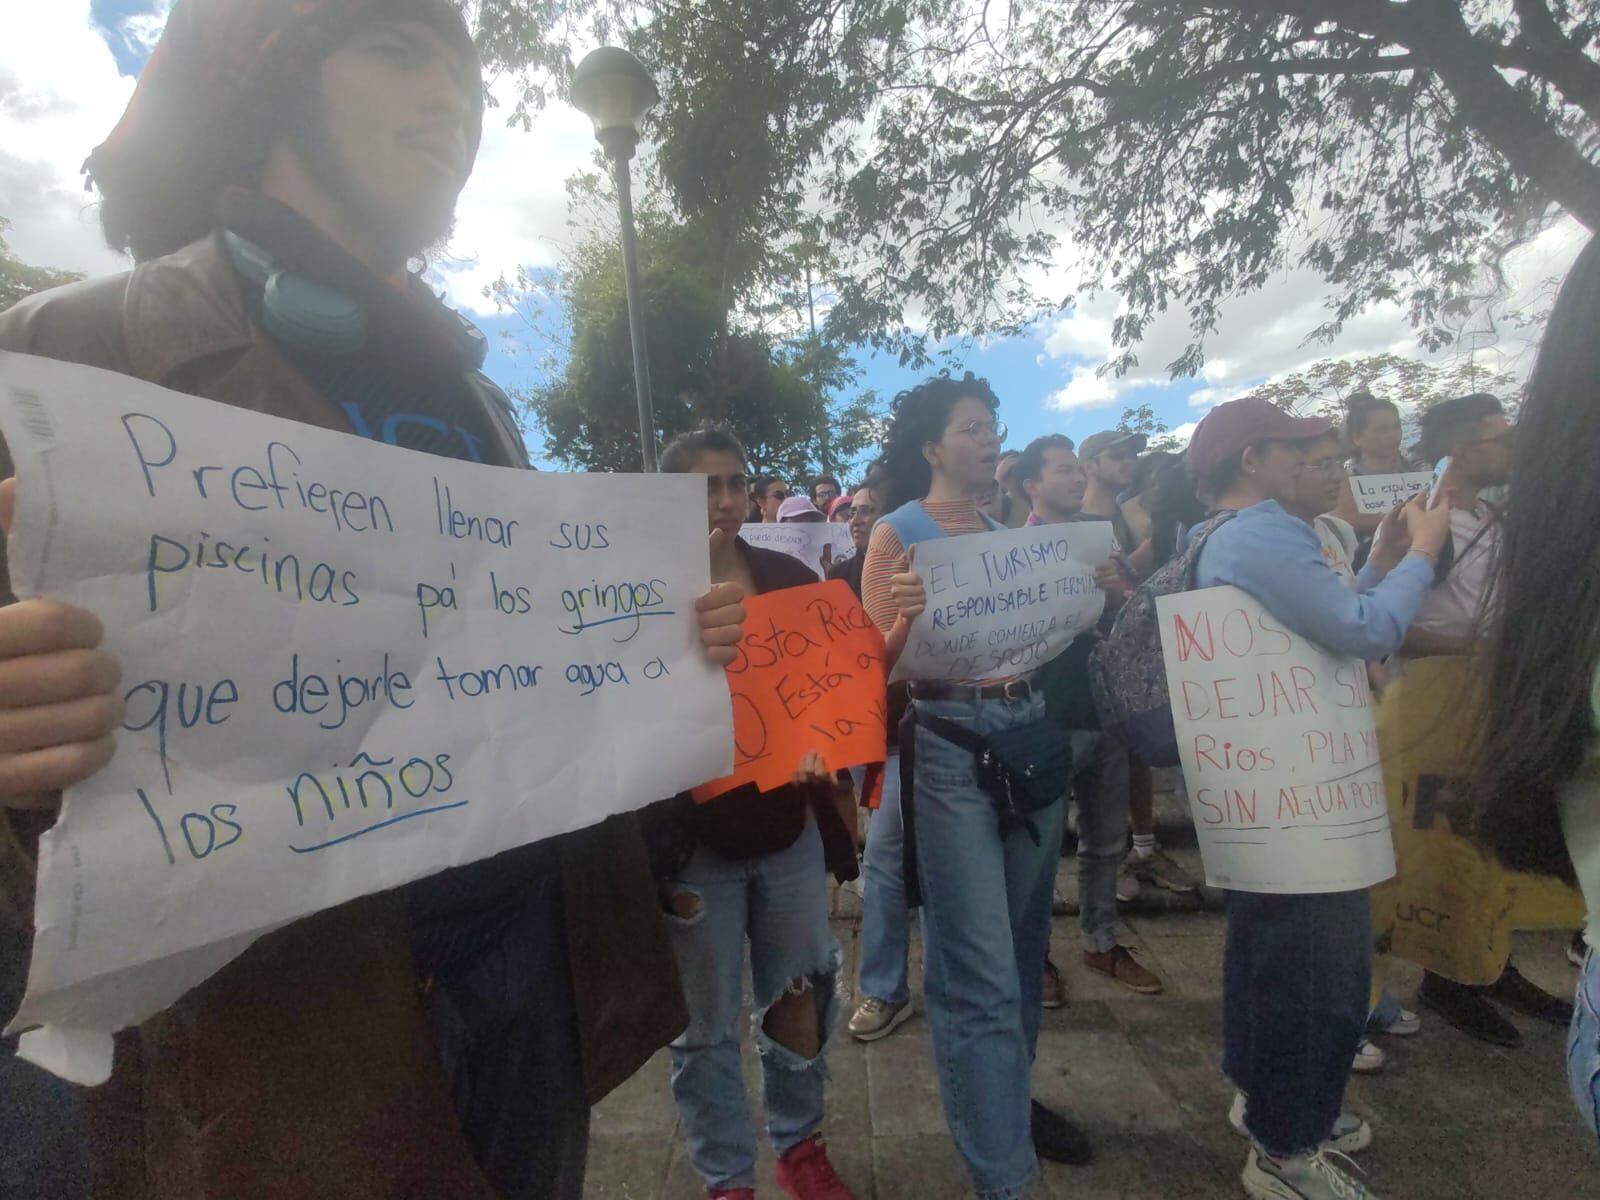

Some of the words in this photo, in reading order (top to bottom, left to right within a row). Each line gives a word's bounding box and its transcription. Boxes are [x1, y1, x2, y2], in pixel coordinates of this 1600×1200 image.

[121, 412, 394, 532] Prefieren
[433, 476, 519, 549] llenar
[549, 522, 610, 551] sus
[147, 531, 361, 612] piscinas
[489, 571, 531, 615] los
[558, 578, 667, 643] gringos
[929, 561, 969, 595] EL
[979, 538, 1069, 588] TURISMO
[932, 583, 1049, 632] RESPONSABLE
[1055, 574, 1098, 597] TERMIN
[723, 616, 823, 674] osta
[914, 630, 979, 660] DONDE
[987, 615, 1057, 647] COMIENZA
[949, 639, 1050, 675] DESPOJO
[1173, 608, 1292, 663] NOS
[775, 652, 853, 721] Está
[856, 651, 881, 670] a
[1181, 665, 1319, 721] DEJAR
[121, 678, 239, 796] que
[272, 652, 416, 730] dejarle
[436, 656, 543, 701] tomar
[565, 661, 630, 697] agua
[643, 655, 671, 680] a
[136, 788, 242, 865] los
[286, 751, 454, 827] niños
[1196, 788, 1257, 825] SIN
